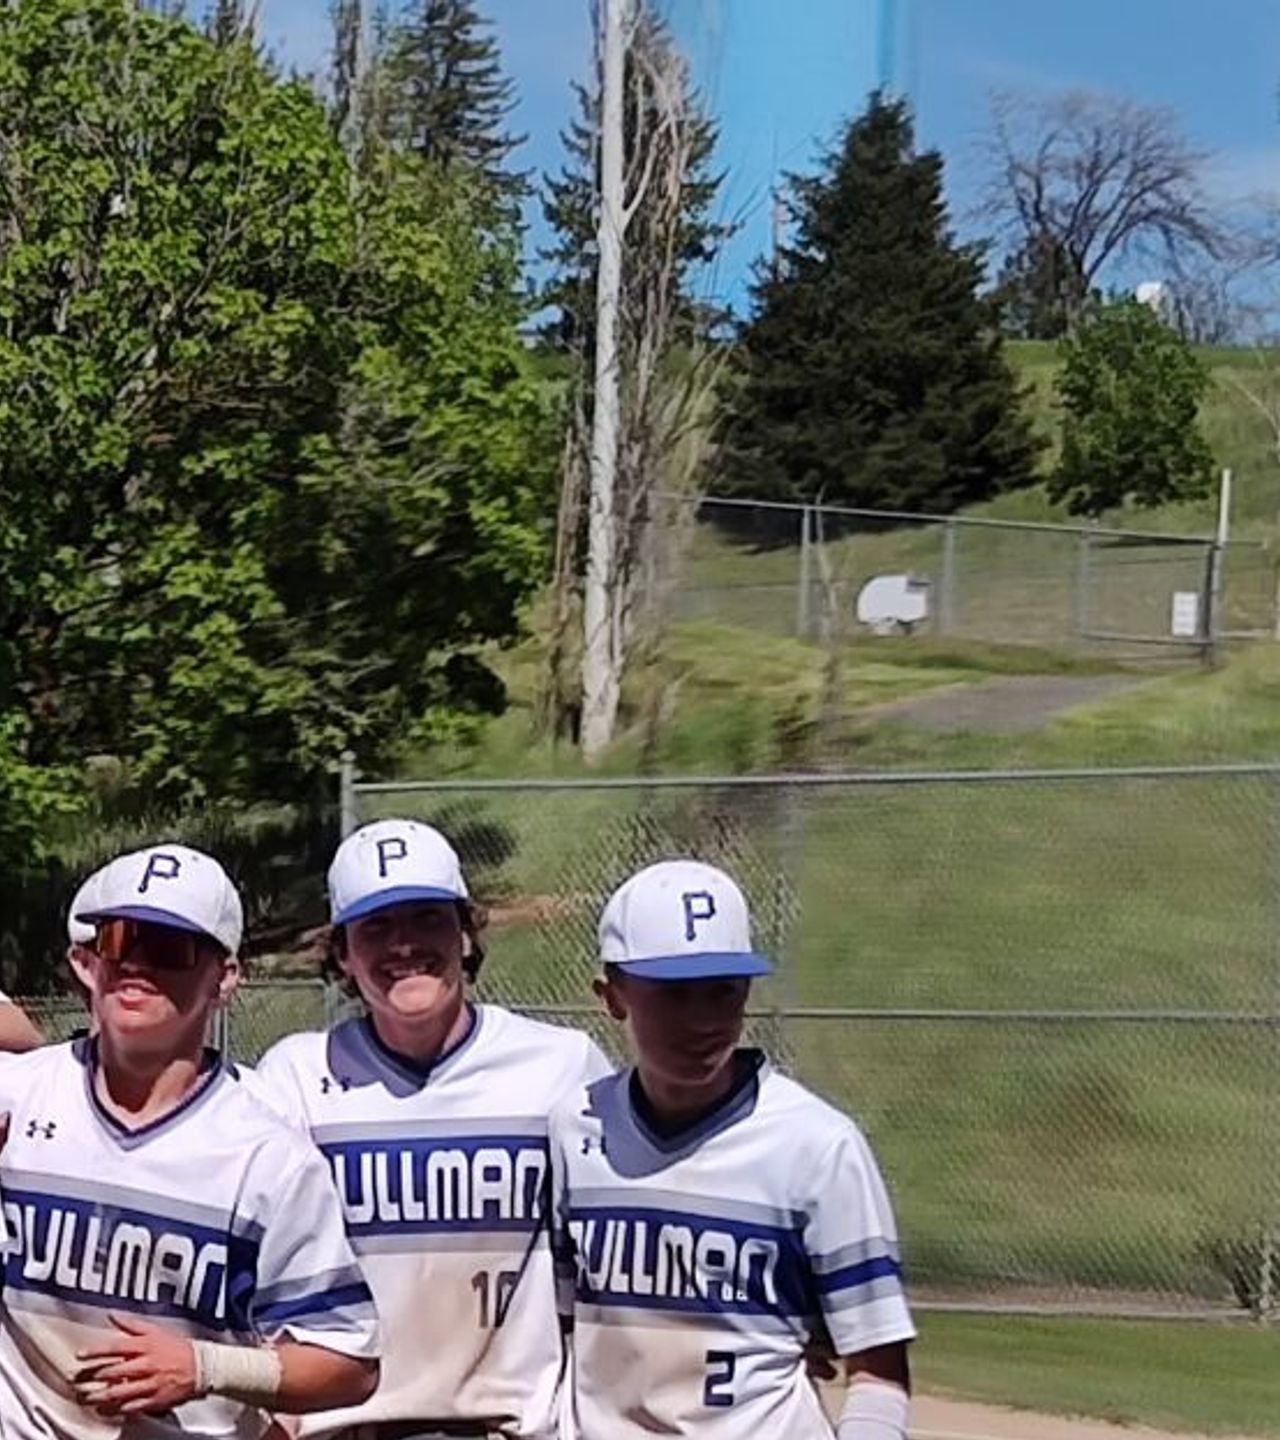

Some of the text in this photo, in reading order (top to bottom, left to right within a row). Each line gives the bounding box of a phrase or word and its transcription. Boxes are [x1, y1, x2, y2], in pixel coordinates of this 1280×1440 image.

[137, 852, 181, 894] P
[375, 837, 408, 878] P
[681, 890, 718, 941] P
[703, 1349, 737, 1407] 2
